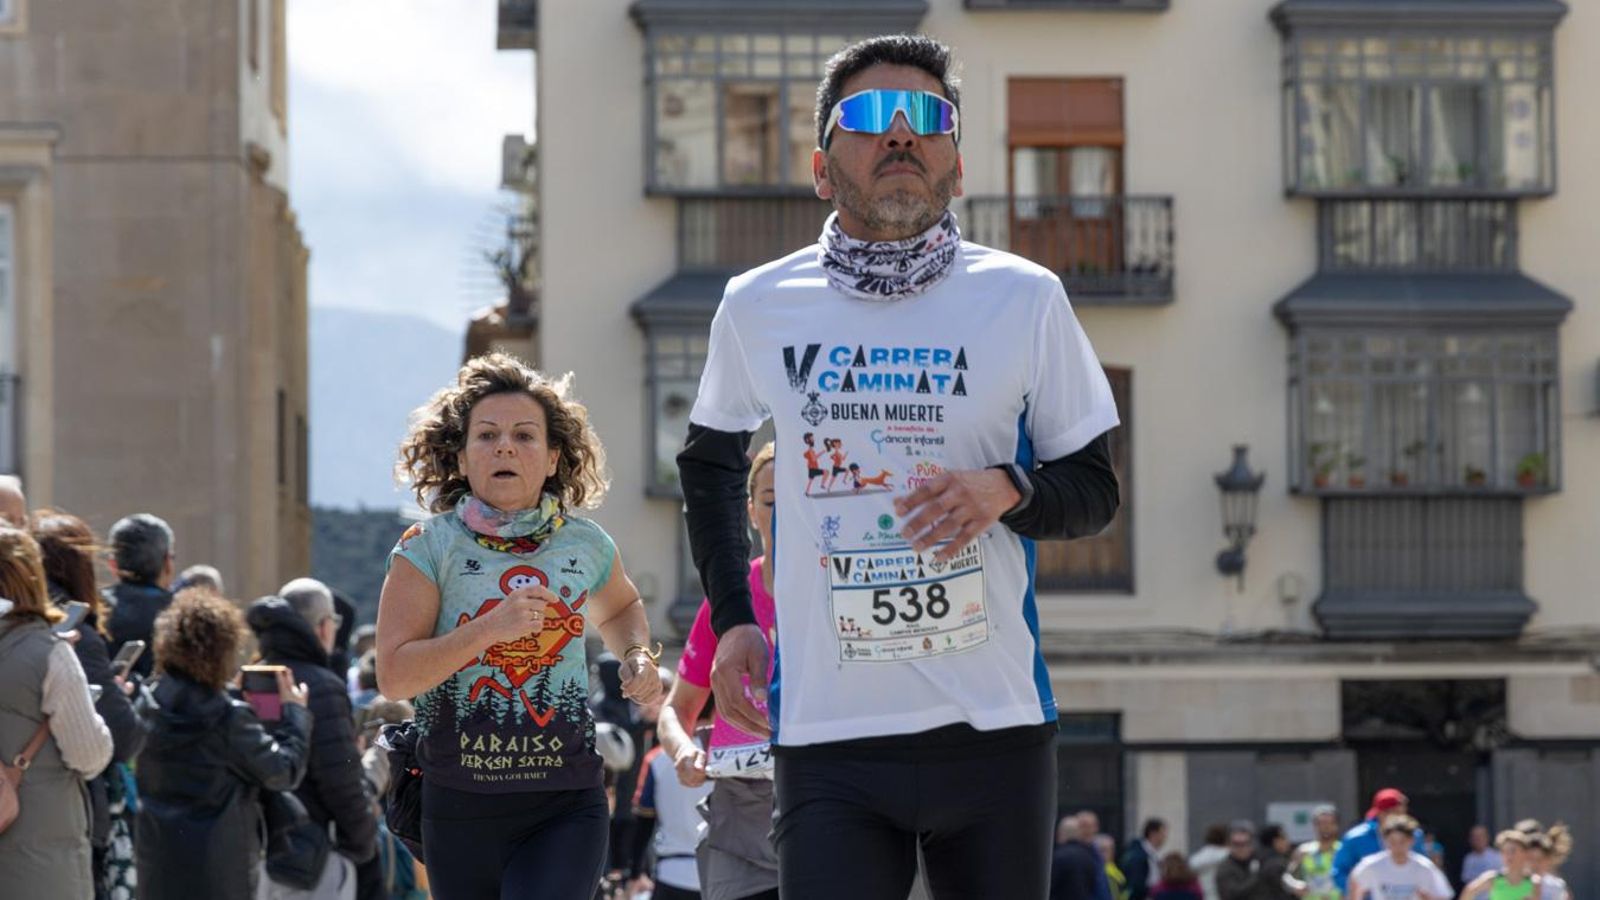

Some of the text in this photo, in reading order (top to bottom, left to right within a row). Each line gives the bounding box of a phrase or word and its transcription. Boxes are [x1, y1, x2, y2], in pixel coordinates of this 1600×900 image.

[829, 345, 968, 371] CARRERA
[818, 369, 967, 396] CAMINATA
[831, 403, 944, 423] BUENA MUERTE
[914, 435, 945, 446] infantil
[856, 553, 924, 570] CARRERA
[950, 555, 979, 570] MUERTE
[853, 567, 925, 583] CAMINATA
[872, 583, 950, 625] 538
[481, 652, 564, 674] Asperger
[460, 731, 563, 752] PARAISO
[461, 753, 564, 770] VIRGEN EXTRA
[473, 771, 548, 782] TIENDA GOURMET
